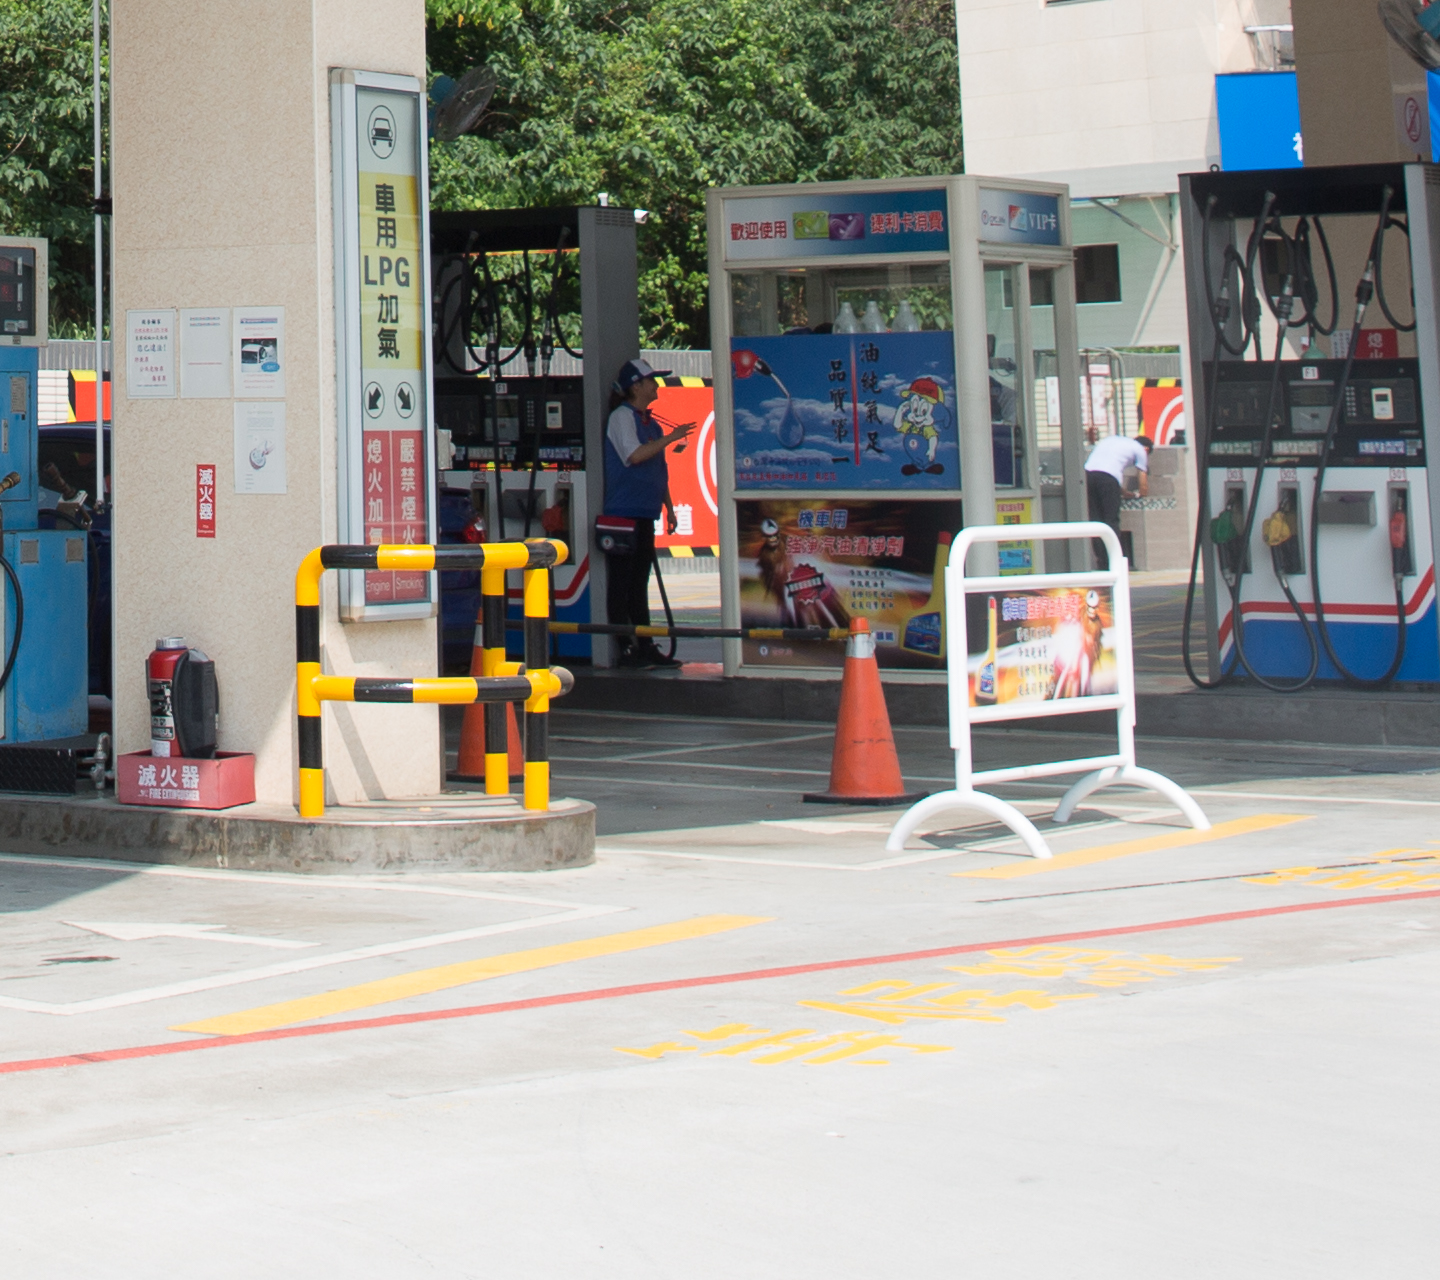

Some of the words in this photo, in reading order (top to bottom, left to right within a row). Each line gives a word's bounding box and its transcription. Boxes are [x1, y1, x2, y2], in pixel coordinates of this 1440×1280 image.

[730, 220, 788, 242] 歡迎使用
[870, 210, 945, 234] 捷利卡消費
[363, 256, 411, 290] LPG
[827, 359, 850, 464] 品質第一
[199, 468, 214, 520] 滅火器
[797, 509, 849, 530] 機車用
[366, 580, 390, 596] Engine
[396, 577, 424, 592] Smoking
[138, 764, 200, 789] 滅火器
